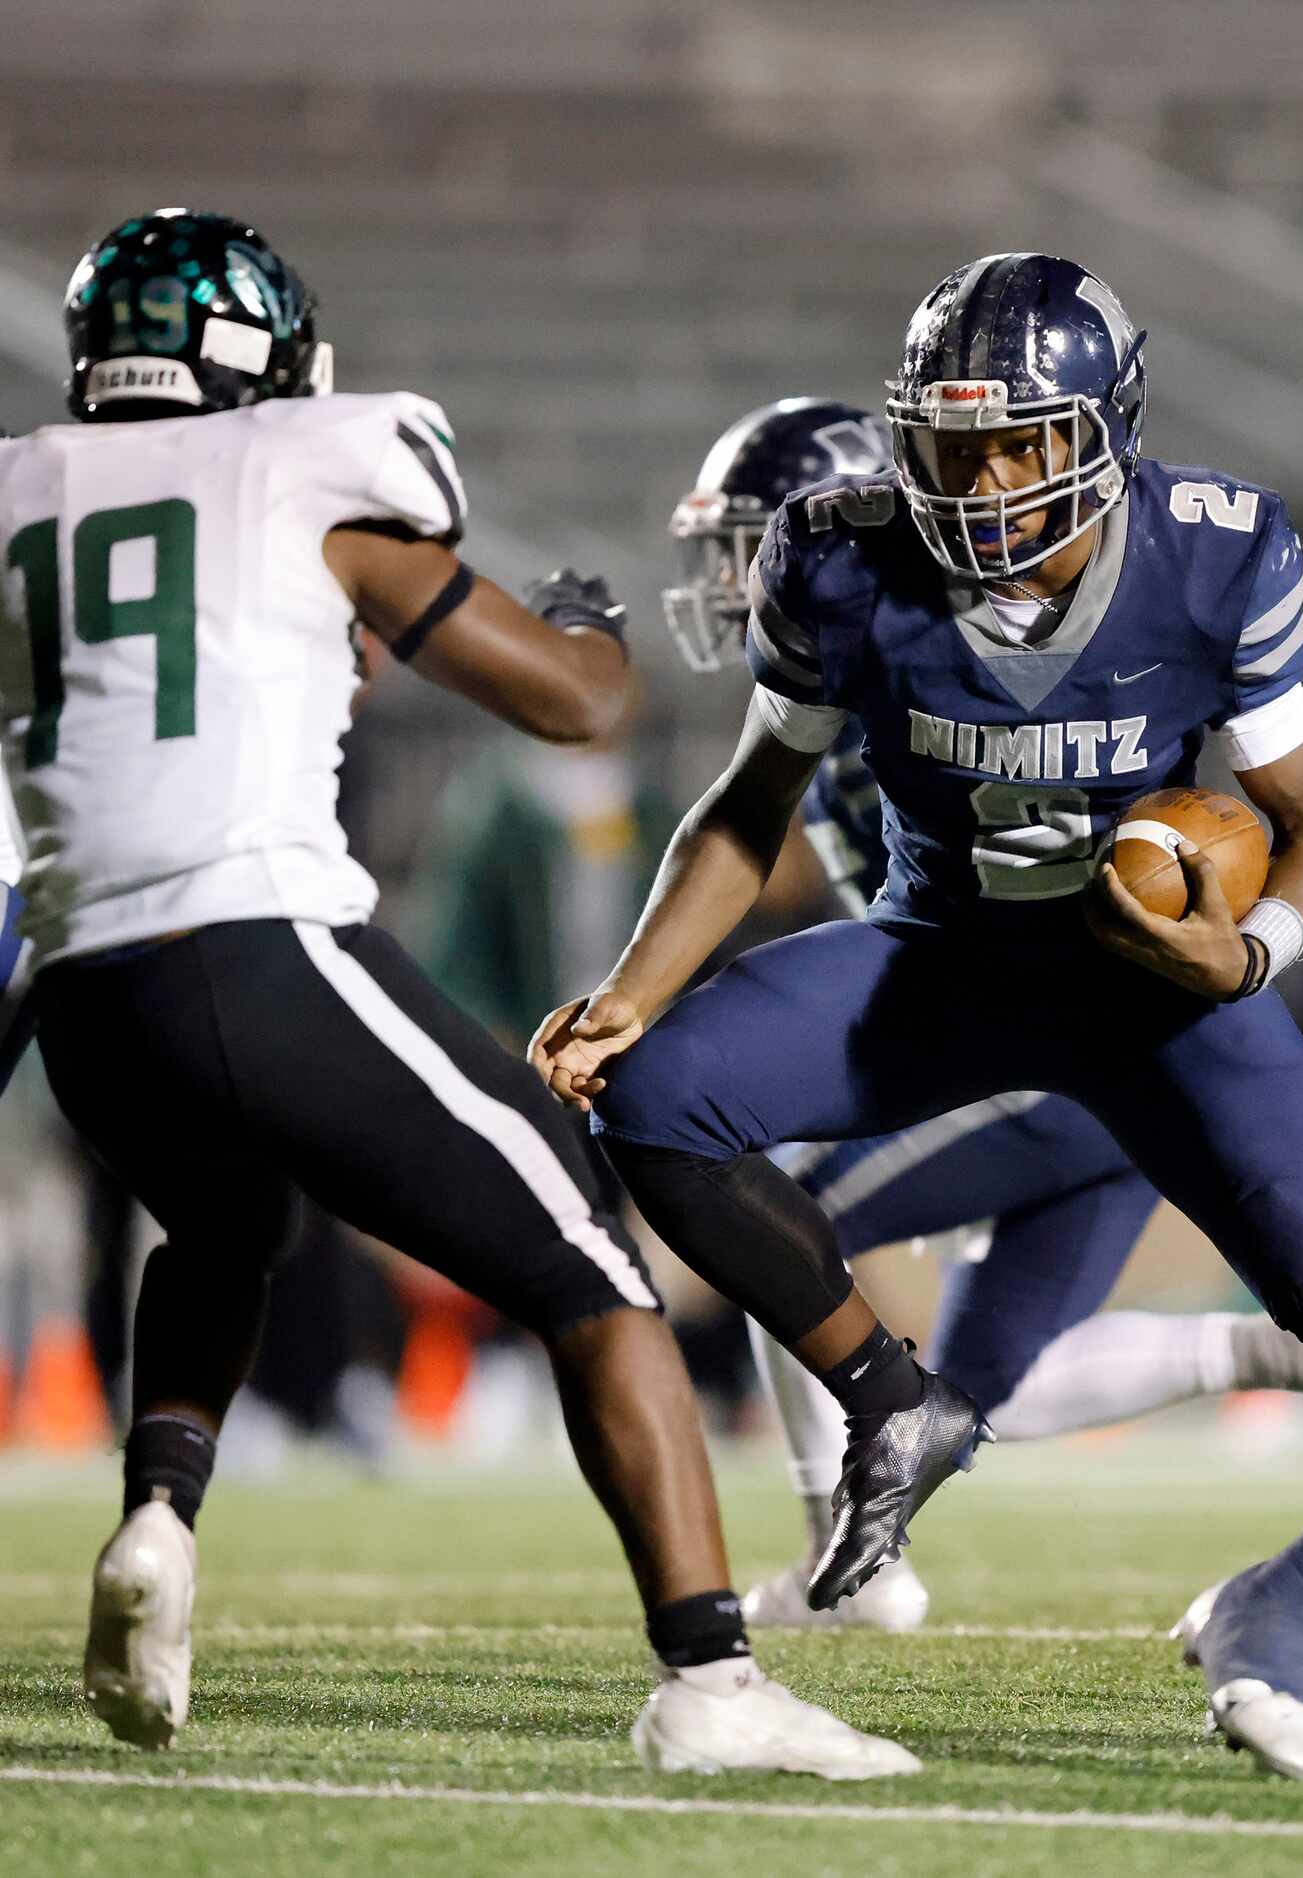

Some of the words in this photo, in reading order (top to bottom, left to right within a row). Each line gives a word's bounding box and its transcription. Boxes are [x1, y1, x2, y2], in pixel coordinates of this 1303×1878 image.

[107, 275, 190, 353] 19
[806, 485, 896, 534] 2
[1169, 481, 1260, 533] 2
[7, 497, 197, 772] 19
[907, 708, 1148, 782] NIMITZ
